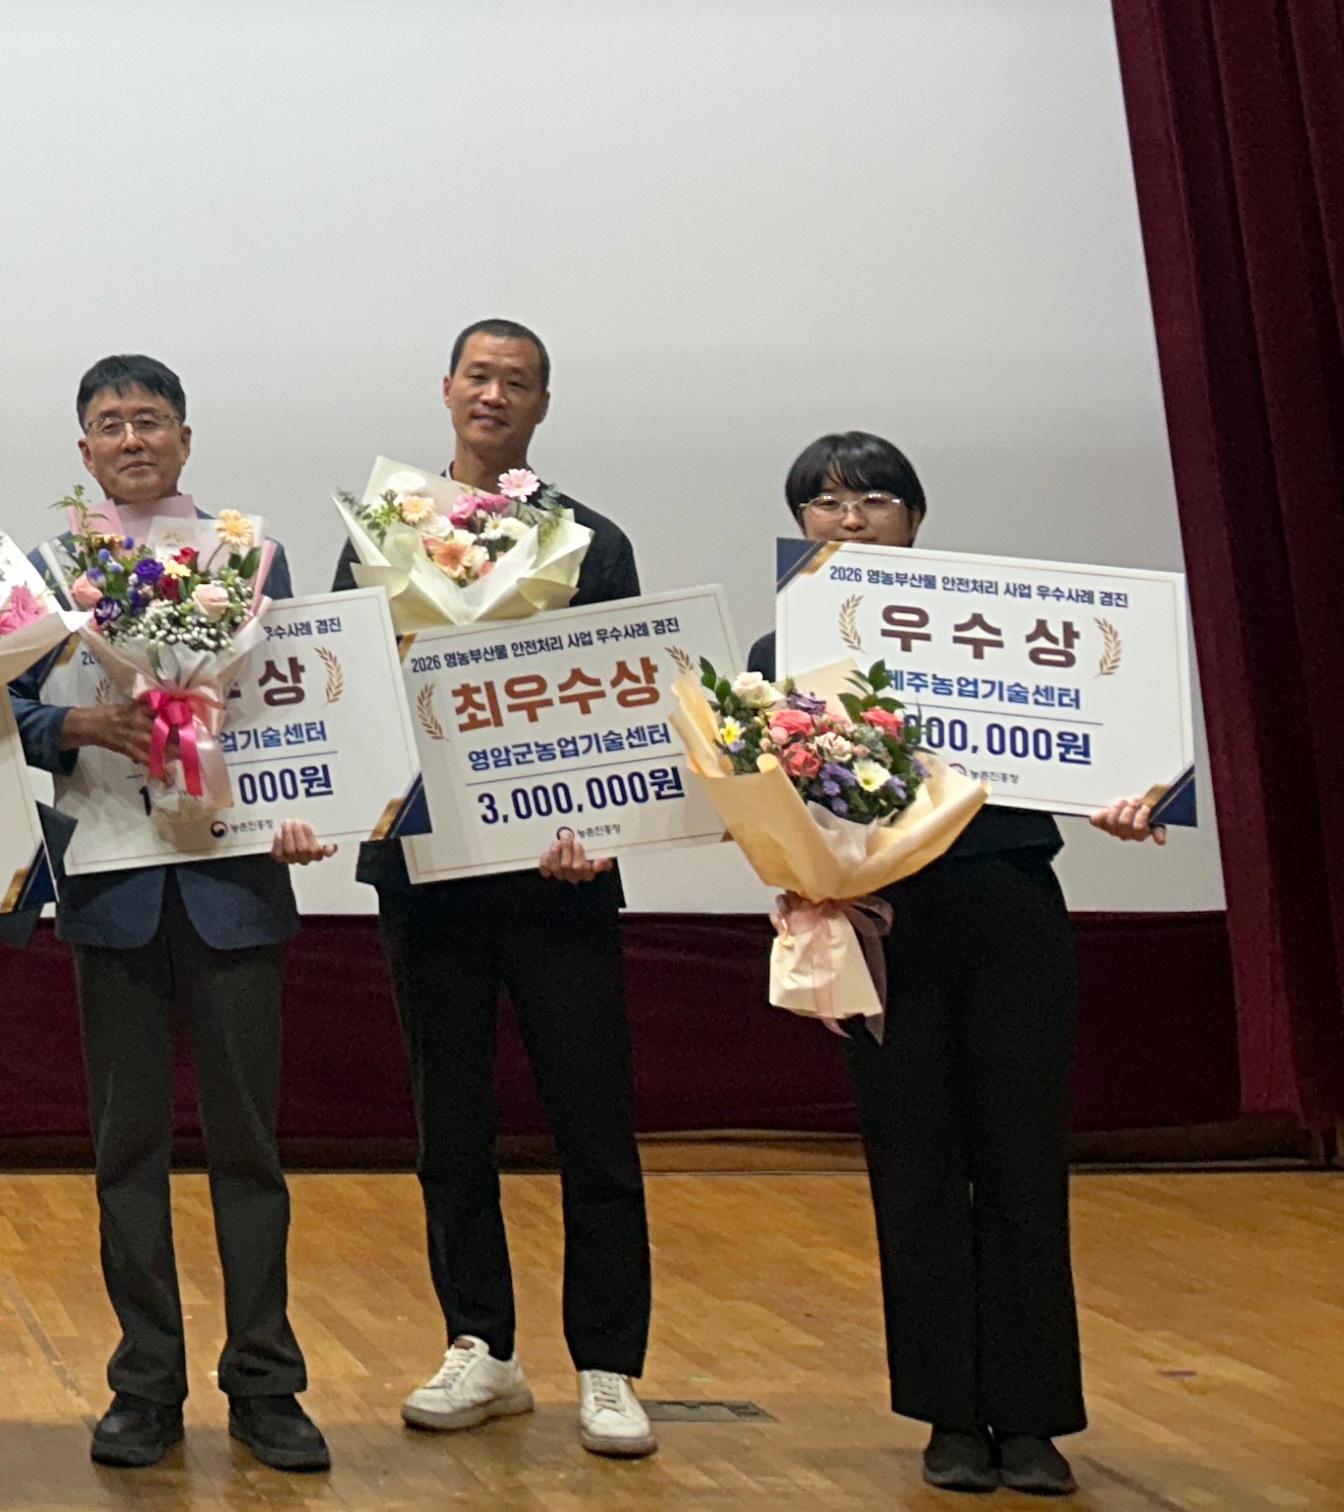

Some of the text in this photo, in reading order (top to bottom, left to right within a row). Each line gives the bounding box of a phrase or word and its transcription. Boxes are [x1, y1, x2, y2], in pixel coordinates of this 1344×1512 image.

[830, 566, 862, 583] 2026
[941, 576, 999, 596] 안전처리
[1003, 582, 1032, 599] 사업
[1036, 585, 1095, 606] 우수사례
[411, 655, 440, 673] 2026
[511, 636, 563, 657] 안전처리
[568, 631, 593, 648] 사업
[596, 622, 650, 644] 우수사례
[451, 656, 660, 733] 최우수상
[468, 722, 671, 771] 영암군농업기술센터
[477, 766, 685, 824] 3,000,000원
